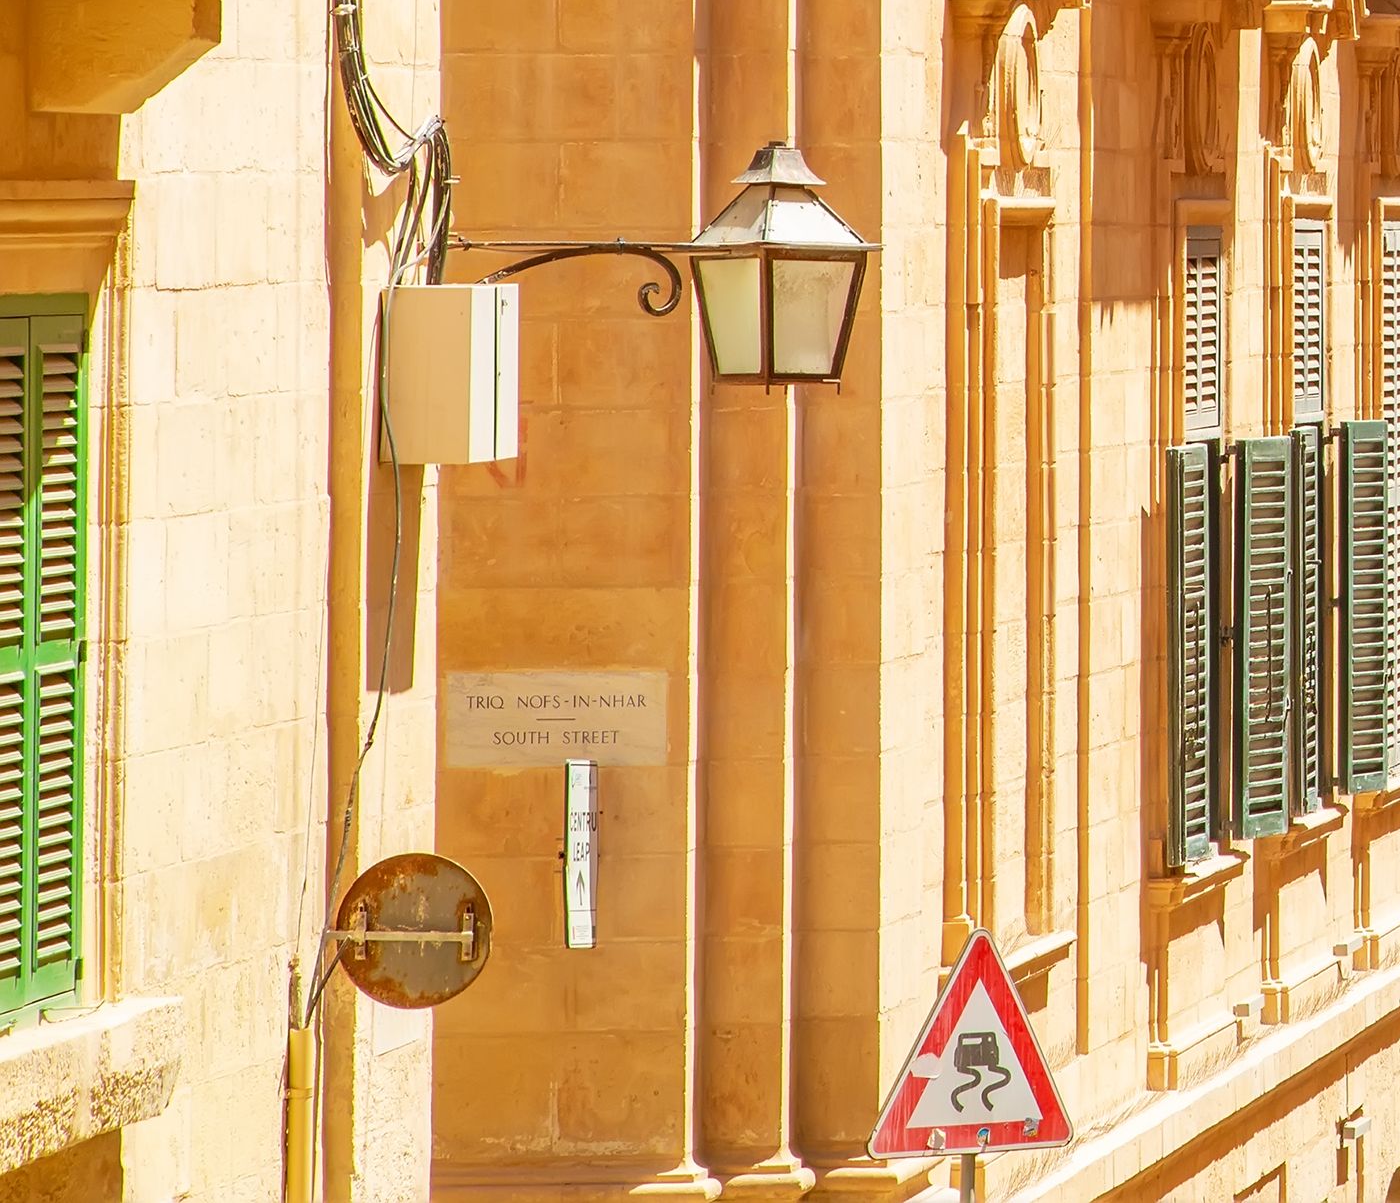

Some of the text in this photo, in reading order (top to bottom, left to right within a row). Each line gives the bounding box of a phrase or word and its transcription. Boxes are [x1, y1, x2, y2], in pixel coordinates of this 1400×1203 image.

[466, 694, 647, 710] TRIQ NOFS-IN-NHAR
[492, 729, 620, 746] SOUTH STREET
[573, 841, 590, 862] LEAP
